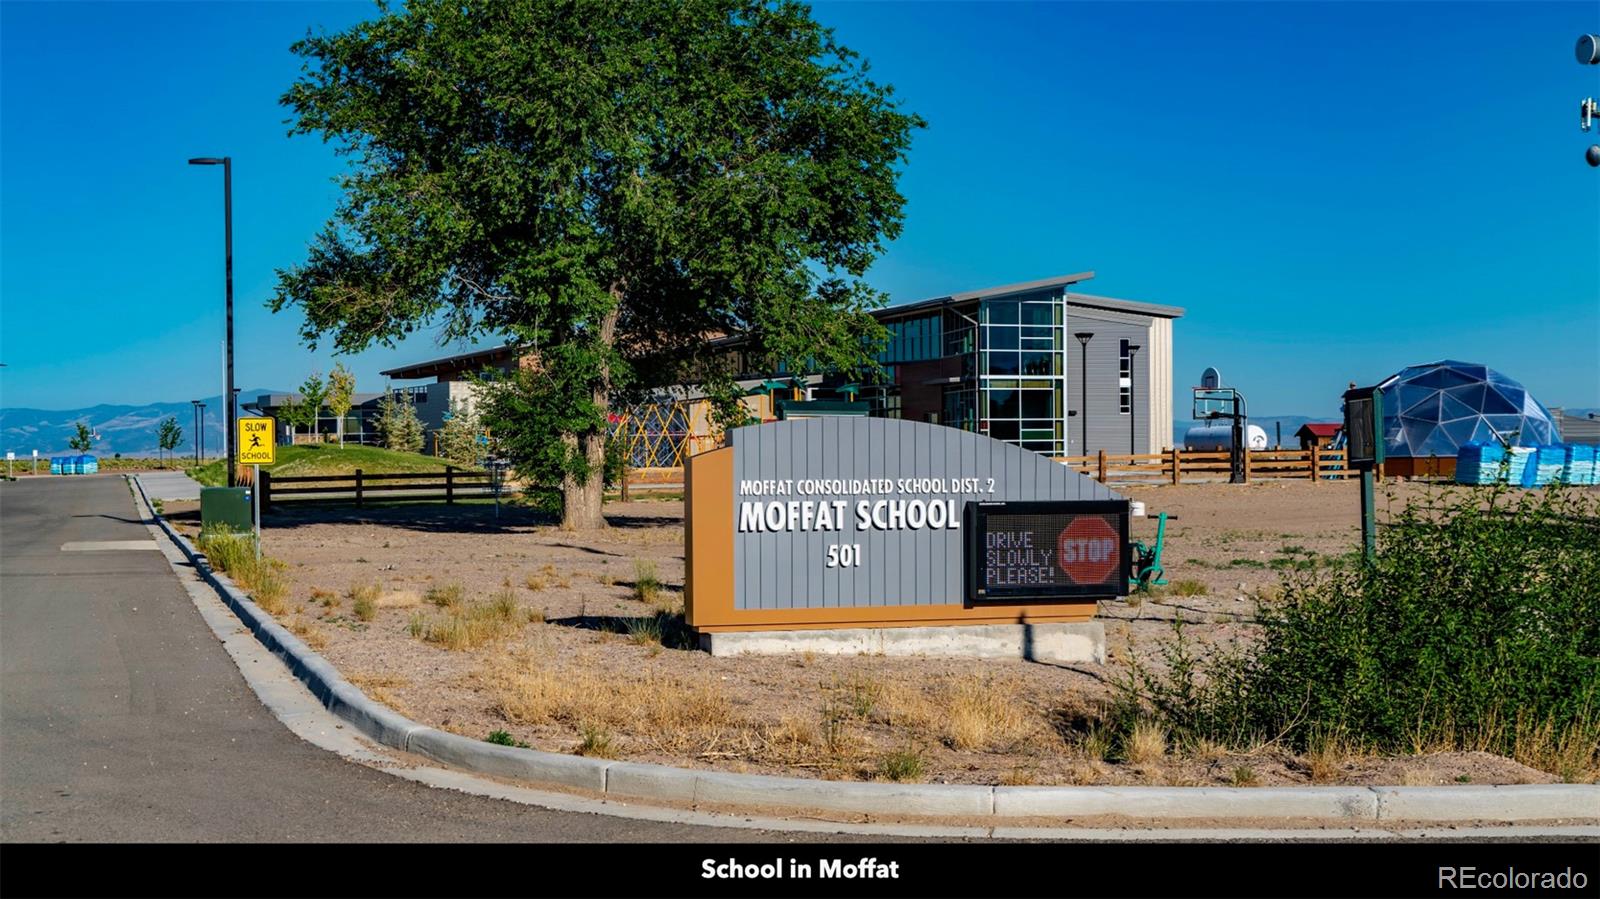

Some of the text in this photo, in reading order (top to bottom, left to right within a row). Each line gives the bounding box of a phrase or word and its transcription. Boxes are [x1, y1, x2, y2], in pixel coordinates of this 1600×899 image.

[245, 422, 267, 432] SLOW
[241, 452, 271, 460] SCHOOL
[740, 478, 995, 496] MOFFAT CONSOLIDATED SCHOOL DIST. 2
[739, 499, 960, 532] MOFFAT SCHOOL
[986, 531, 1033, 549] DRIVE
[827, 544, 861, 567] 501
[986, 549, 1052, 566] SLOWLY
[1063, 538, 1114, 562] STOP
[986, 567, 1054, 584] PLEASE!
